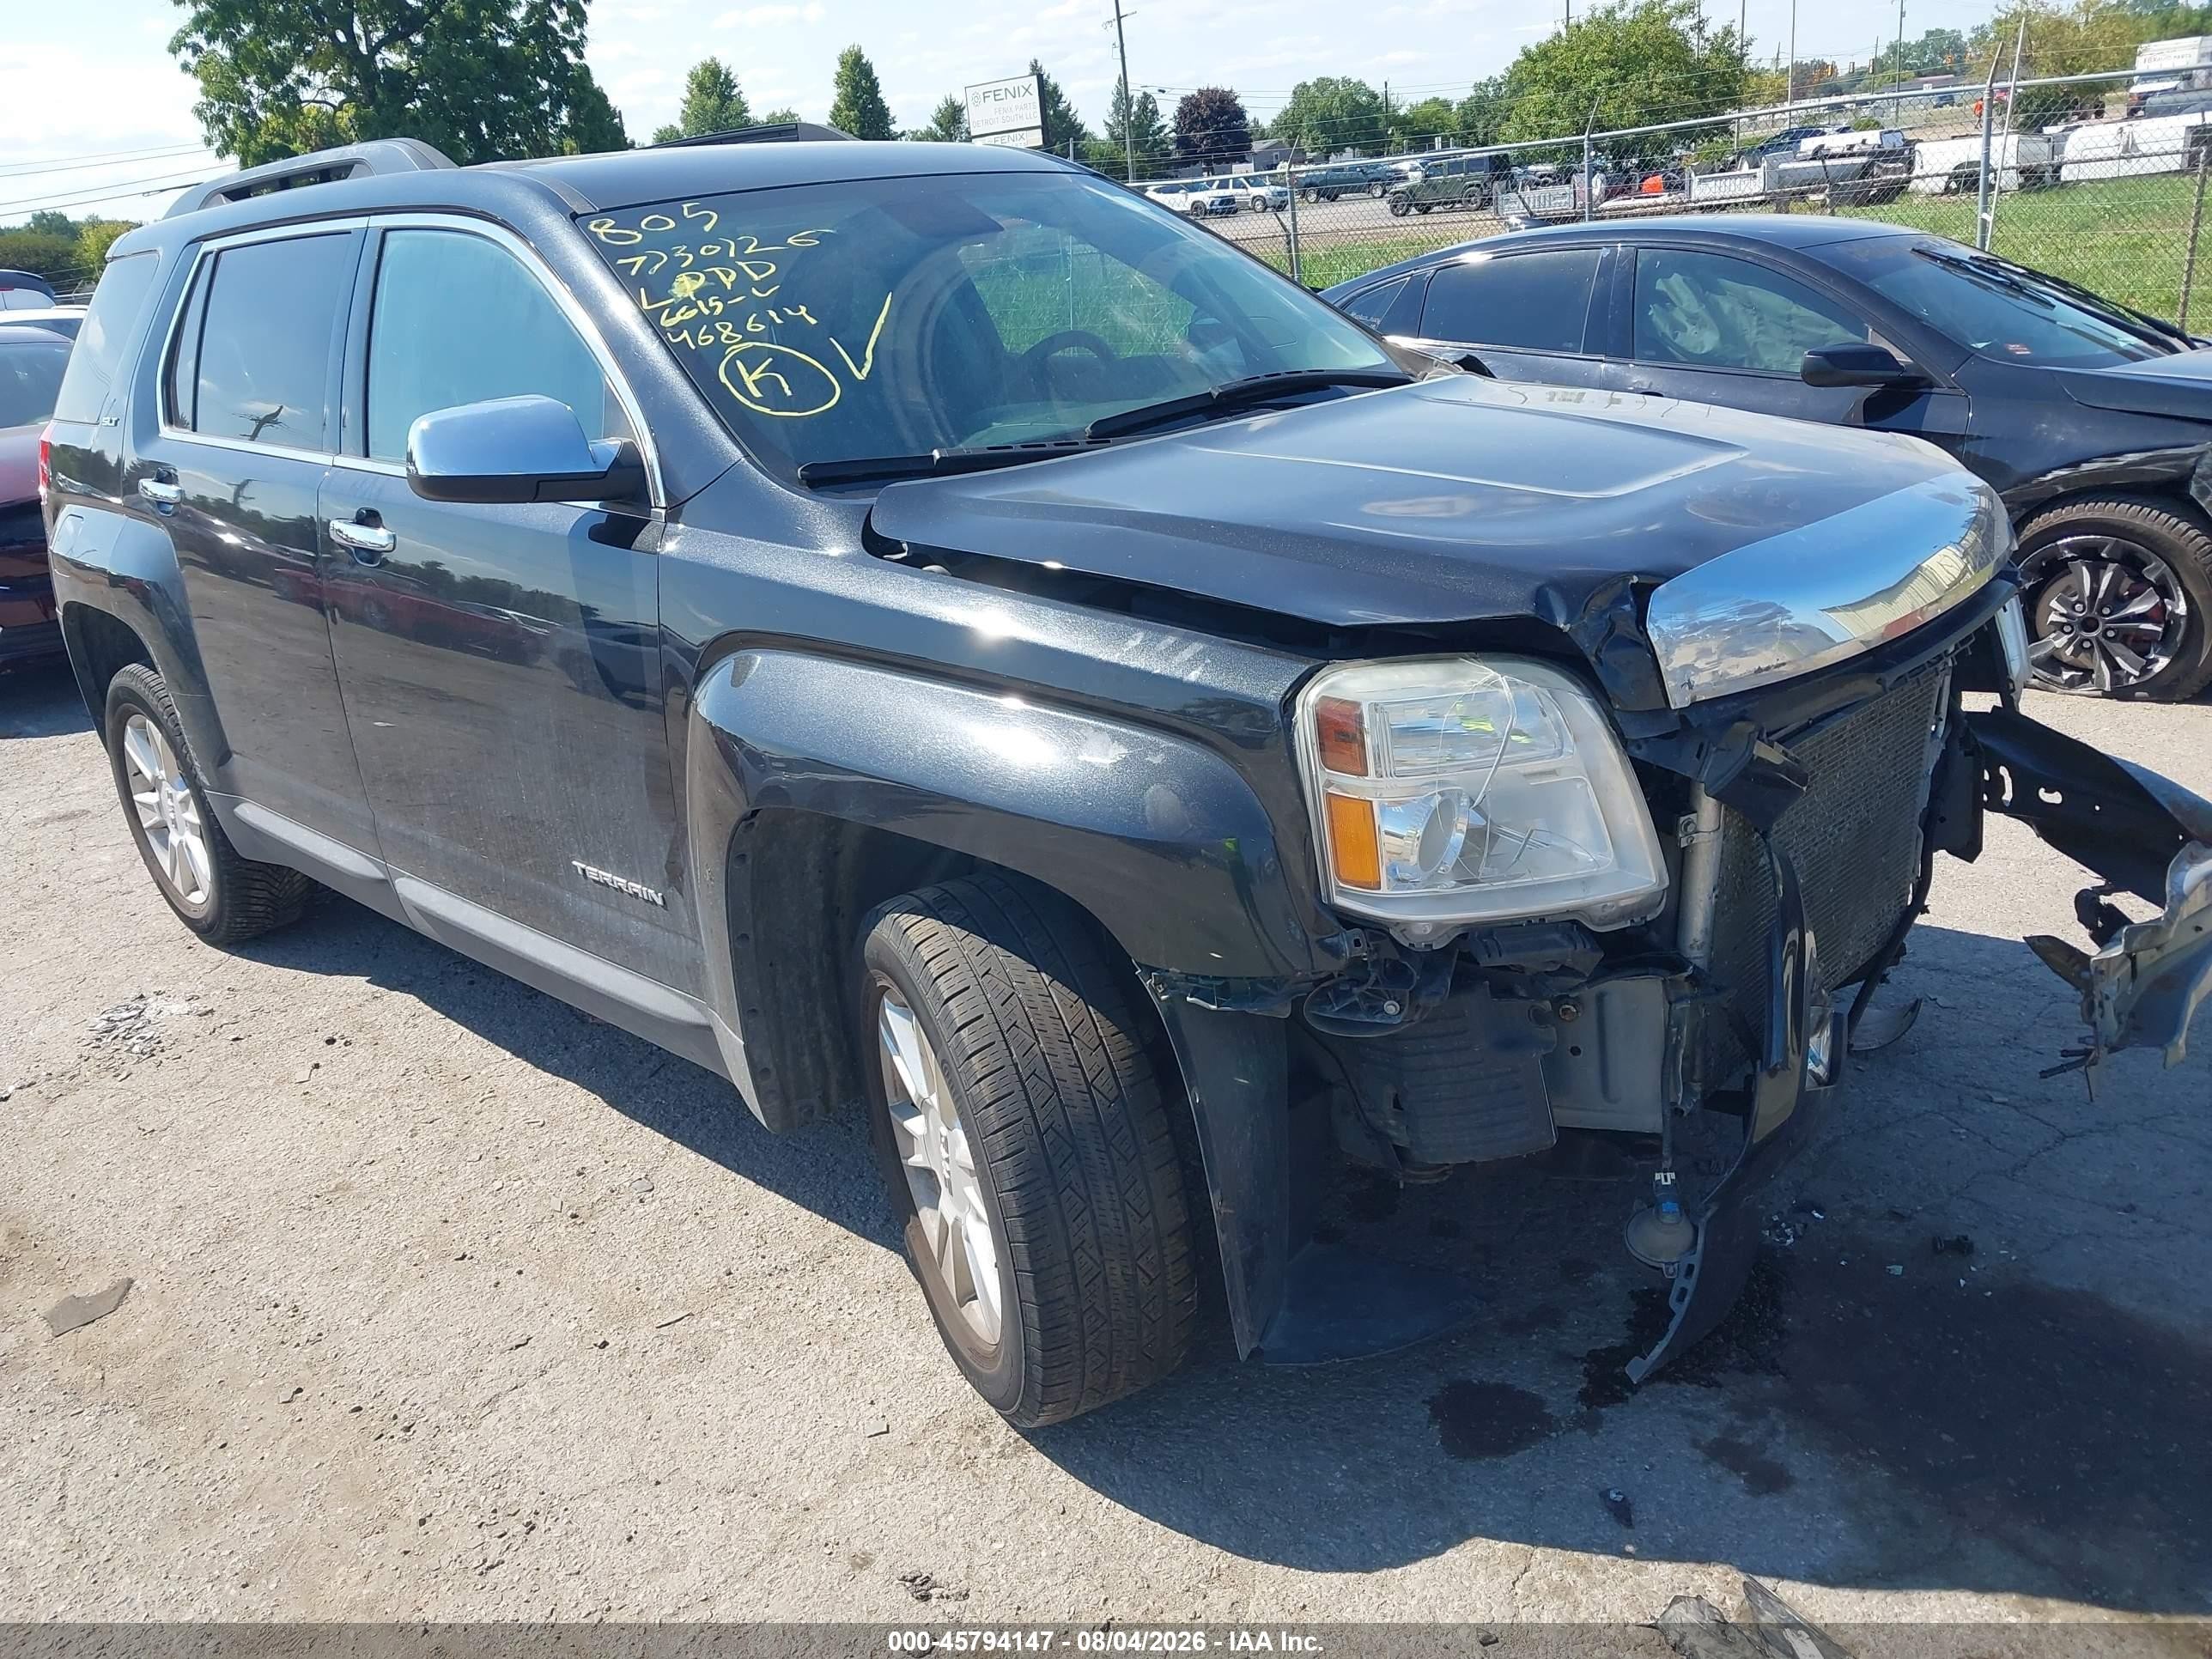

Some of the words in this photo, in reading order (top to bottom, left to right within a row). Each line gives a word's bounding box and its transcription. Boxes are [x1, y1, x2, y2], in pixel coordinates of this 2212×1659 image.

[982, 83, 1033, 104] FENIX
[994, 105, 1013, 115] FENIX
[972, 117, 999, 129] DETROIT
[1001, 112, 1024, 124] SOUTH
[1025, 111, 1038, 120] LLC
[994, 133, 1025, 144] FENIX
[101, 416, 118, 427] SLT
[571, 860, 665, 907] TERRAIN
